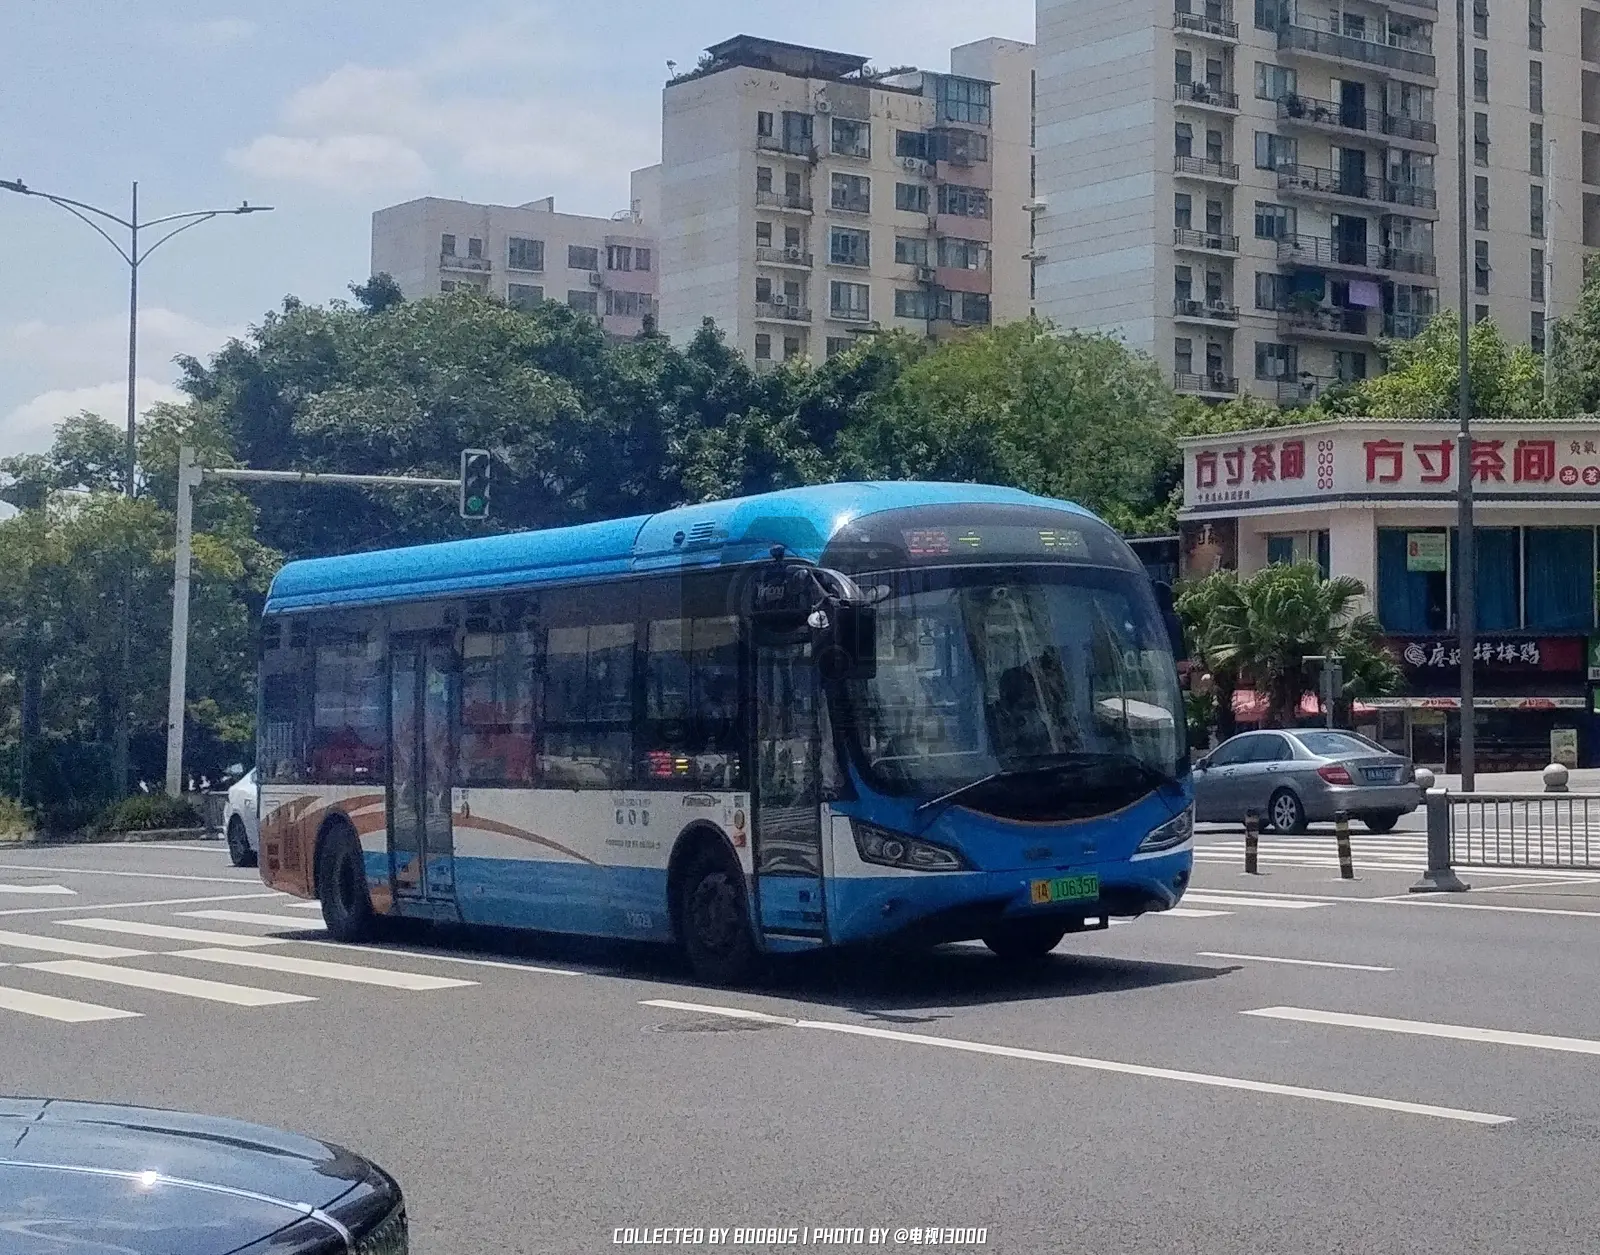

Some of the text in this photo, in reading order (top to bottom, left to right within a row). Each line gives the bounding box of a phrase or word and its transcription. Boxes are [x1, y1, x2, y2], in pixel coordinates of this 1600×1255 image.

[1195, 440, 1305, 489] 方寸茶间
[1363, 438, 1556, 484] 方寸茶间
